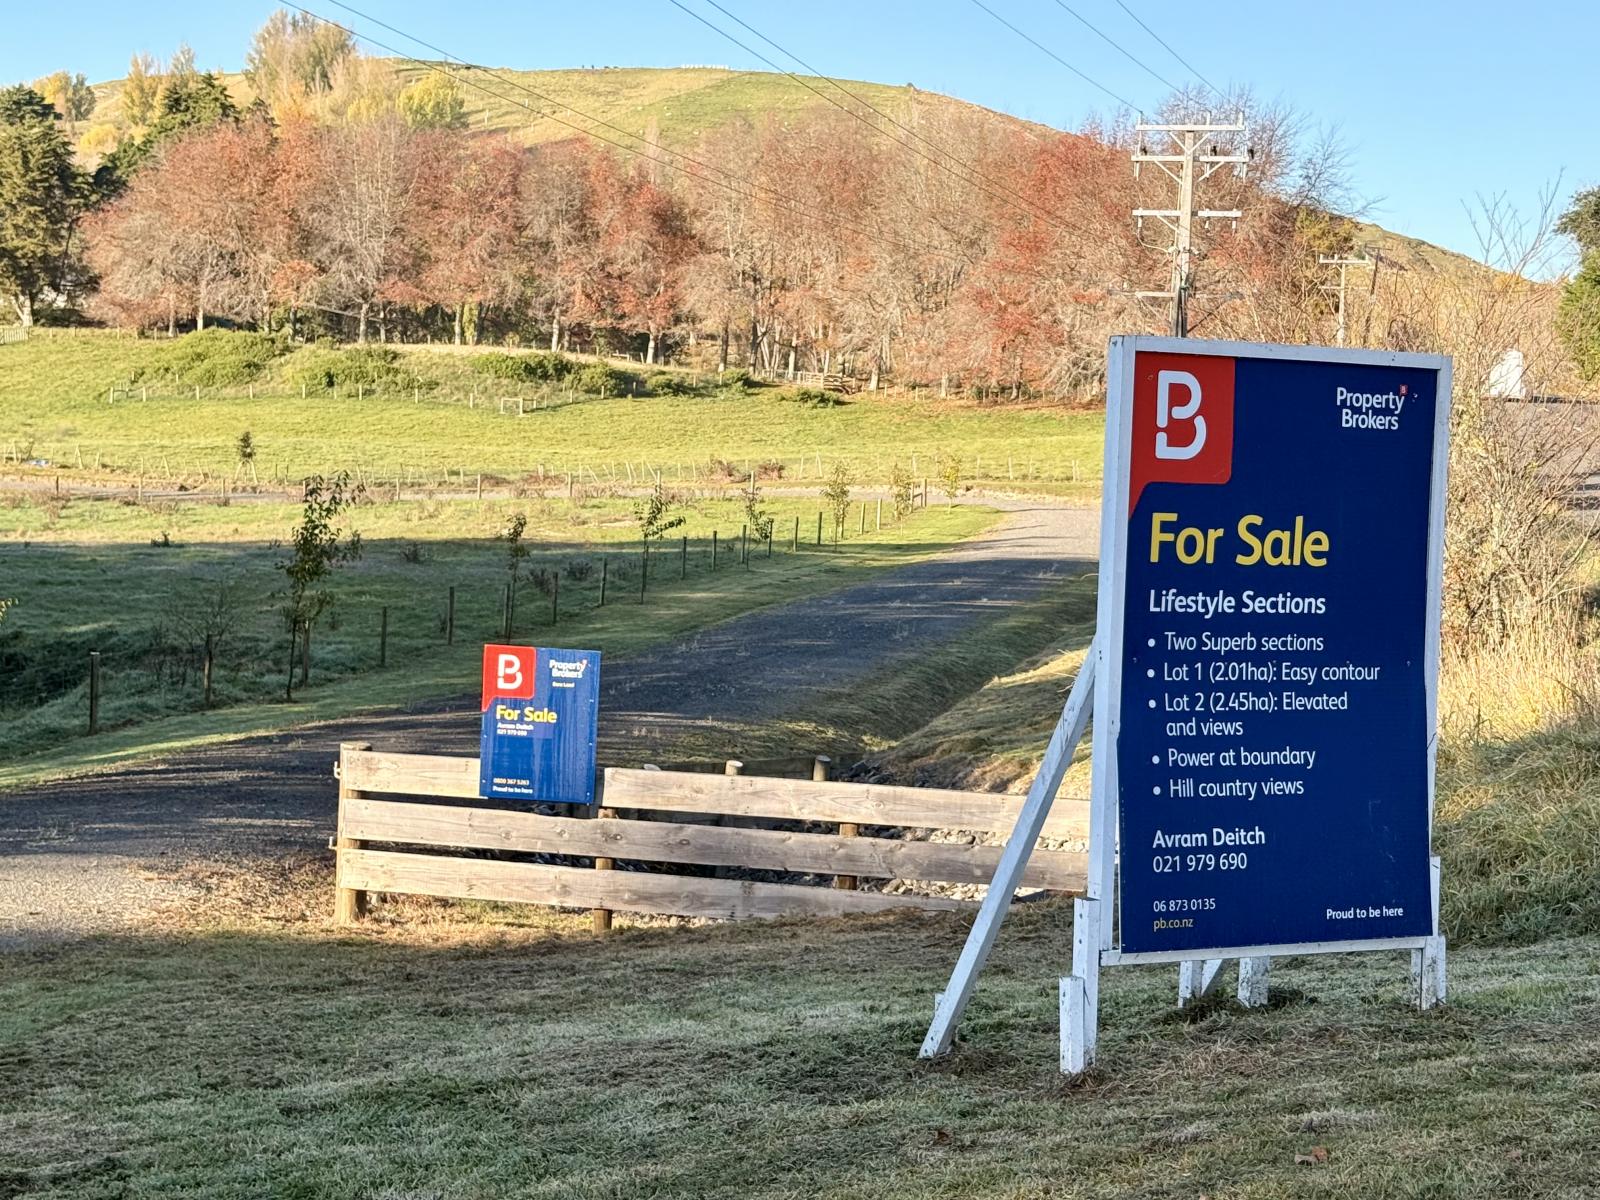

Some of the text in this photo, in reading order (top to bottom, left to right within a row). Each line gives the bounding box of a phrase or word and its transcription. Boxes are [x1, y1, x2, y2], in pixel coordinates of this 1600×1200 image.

[1336, 386, 1405, 414] Property
[1341, 408, 1399, 430] Brokers
[1149, 512, 1330, 567] For Sale
[1149, 588, 1326, 619] Lifestyle Sections
[1164, 631, 1324, 656] Two Superb sections
[549, 659, 586, 673] Property
[1164, 660, 1381, 685] Lot 1 (2.01ha): Easy contour
[496, 704, 557, 723] For Sale
[1164, 691, 1348, 714] Lot 2 (2.45ha): Elevated
[1166, 717, 1244, 737] and views
[1168, 745, 1316, 770] Power at boundary
[1169, 777, 1305, 801] Hill country views
[1152, 826, 1266, 849] Avram Deitch
[1152, 852, 1248, 873] 021 979 690
[1153, 897, 1216, 913] 06 873 0135
[1326, 905, 1404, 920] Proud to be here
[1153, 917, 1194, 933] pb.co.nz
